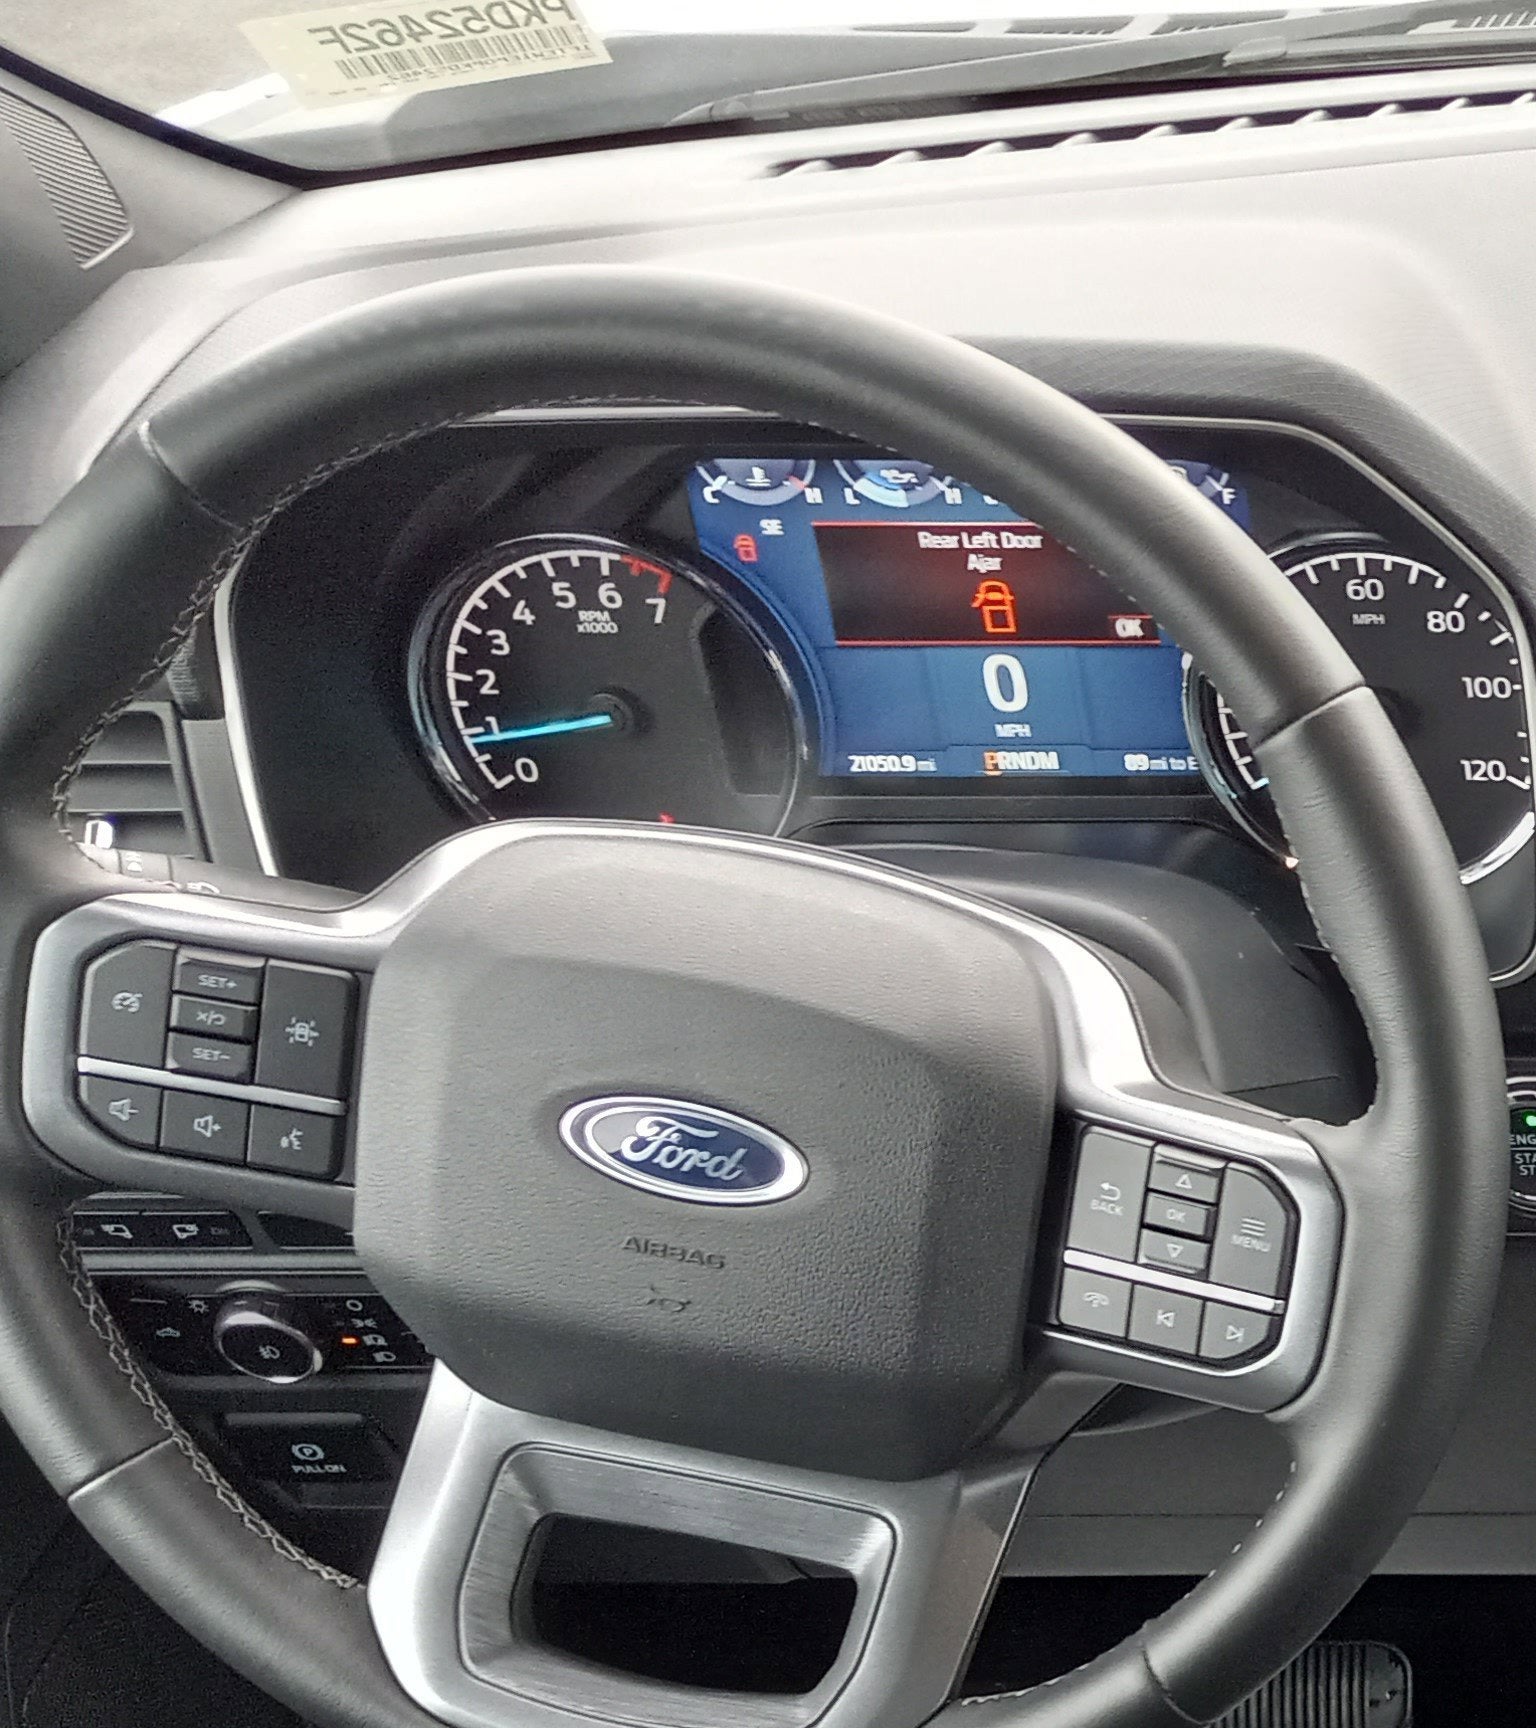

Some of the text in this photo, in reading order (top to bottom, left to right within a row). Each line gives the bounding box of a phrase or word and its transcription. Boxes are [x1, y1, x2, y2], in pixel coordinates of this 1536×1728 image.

[805, 487, 823, 503] H
[844, 487, 860, 505] L
[759, 519, 783, 535] SE
[917, 531, 1043, 549] Rear Left Door
[967, 553, 1003, 573] Ajar
[552, 582, 576, 609] 5
[598, 582, 622, 609] 6
[1345, 578, 1385, 601] 60
[512, 601, 535, 625] 4
[578, 611, 610, 622] RPM
[645, 598, 667, 624] 7
[1352, 613, 1385, 625] MPH
[1426, 610, 1465, 633] 80
[1115, 618, 1145, 638] OK
[485, 630, 511, 655] 3
[475, 669, 499, 695] 2
[983, 653, 1028, 713] 0
[1461, 677, 1512, 699] 100
[516, 758, 538, 782] 0
[1459, 759, 1507, 782] 120
[620, 1115, 748, 1182] Ford
[1089, 1199, 1124, 1217] BACK
[1166, 1209, 1186, 1223] OK
[1231, 1233, 1271, 1253] MENU
